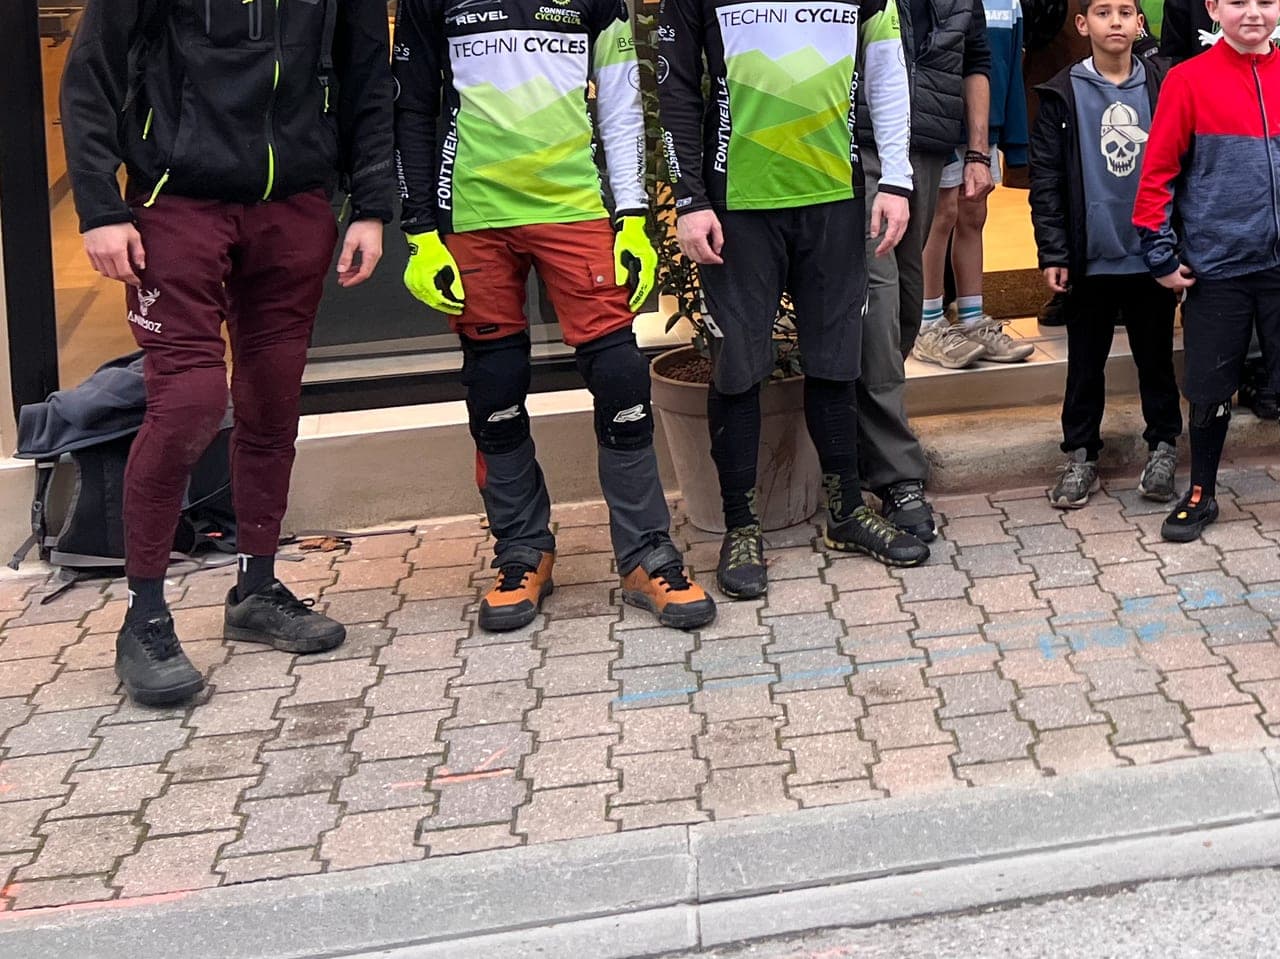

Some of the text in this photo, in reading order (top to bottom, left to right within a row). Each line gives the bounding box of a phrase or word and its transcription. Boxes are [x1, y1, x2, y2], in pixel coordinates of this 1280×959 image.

[456, 10, 508, 26] REVEL
[721, 8, 857, 27] TECHNI CYCLES
[453, 36, 587, 58] TECHNI CYCLES
